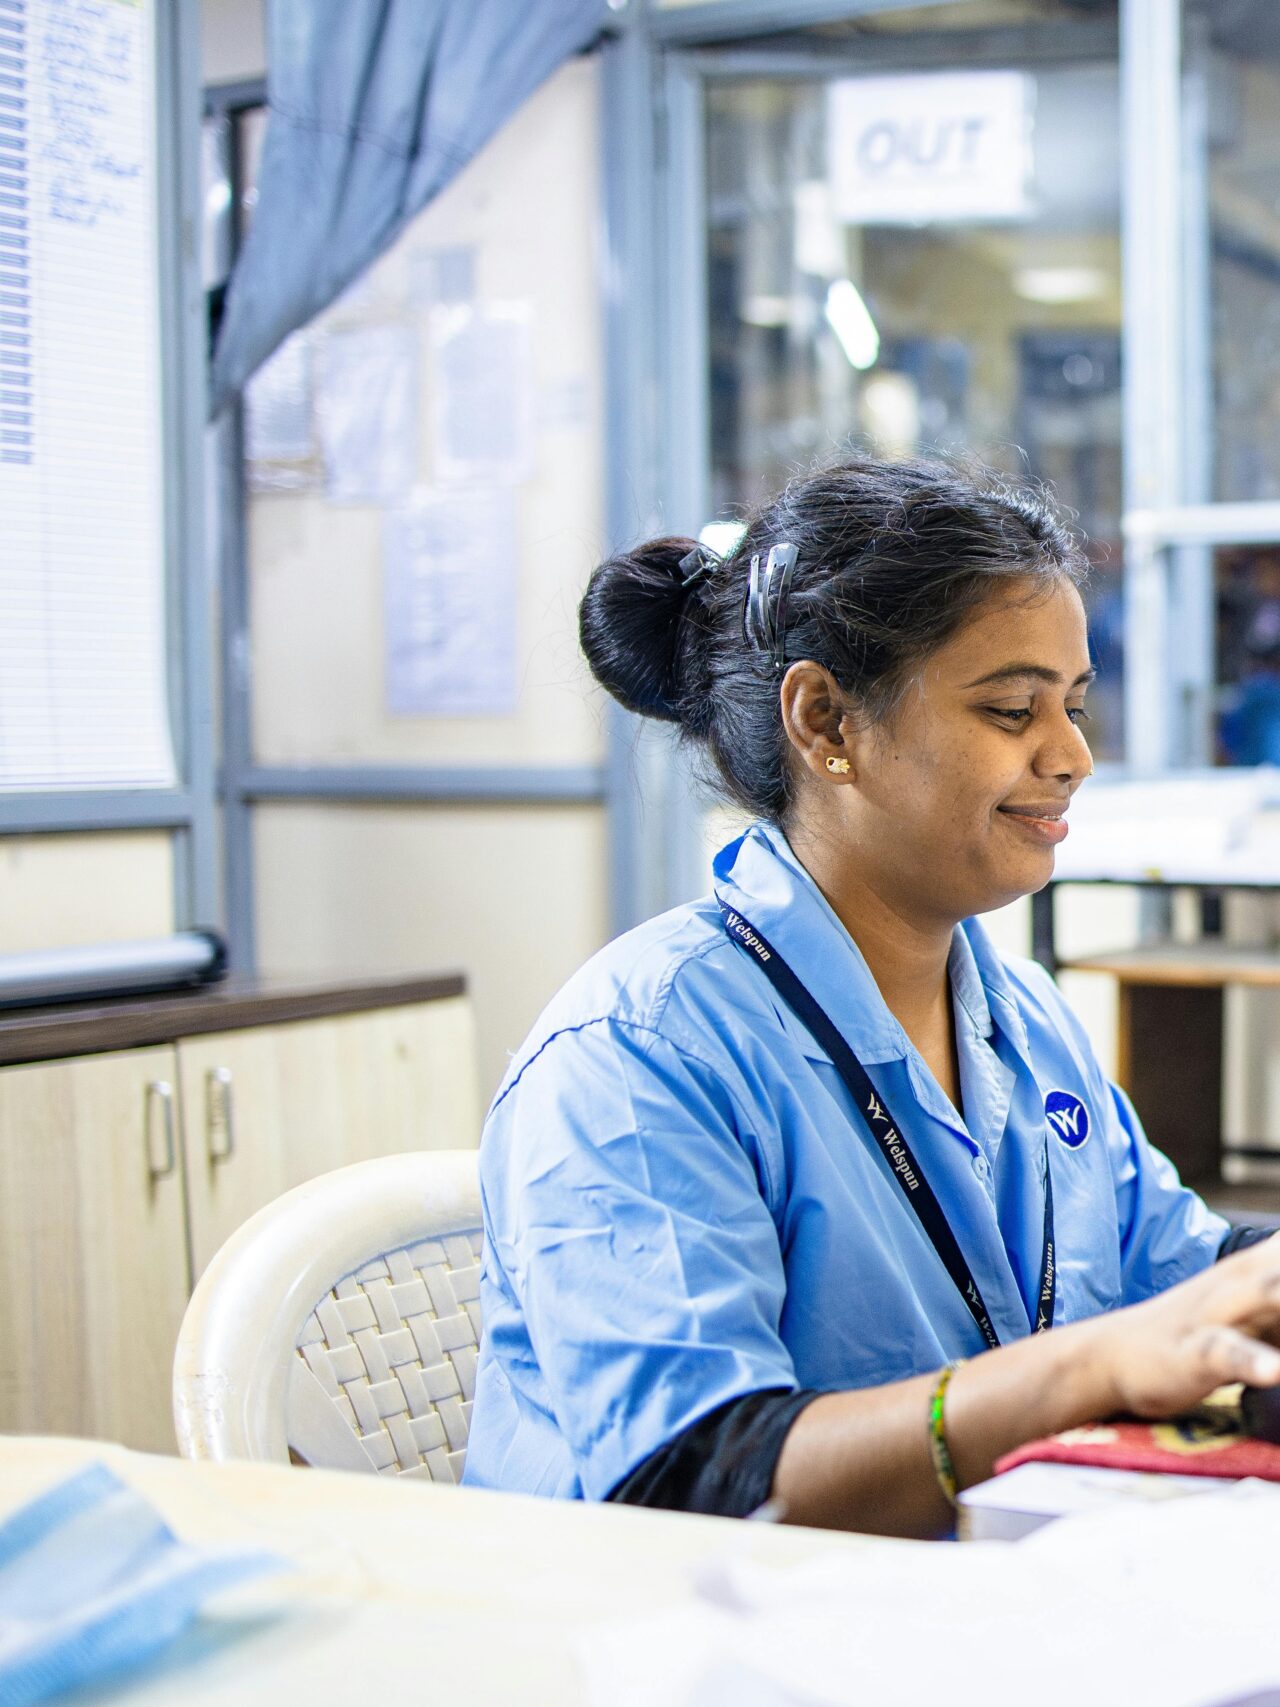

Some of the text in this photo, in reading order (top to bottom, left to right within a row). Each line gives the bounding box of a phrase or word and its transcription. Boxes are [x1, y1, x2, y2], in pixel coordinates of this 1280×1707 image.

[856, 116, 989, 176] OUT
[726, 911, 771, 961] Welspun
[883, 1127, 920, 1191] Welspun
[1041, 1242, 1054, 1301] Welspun
